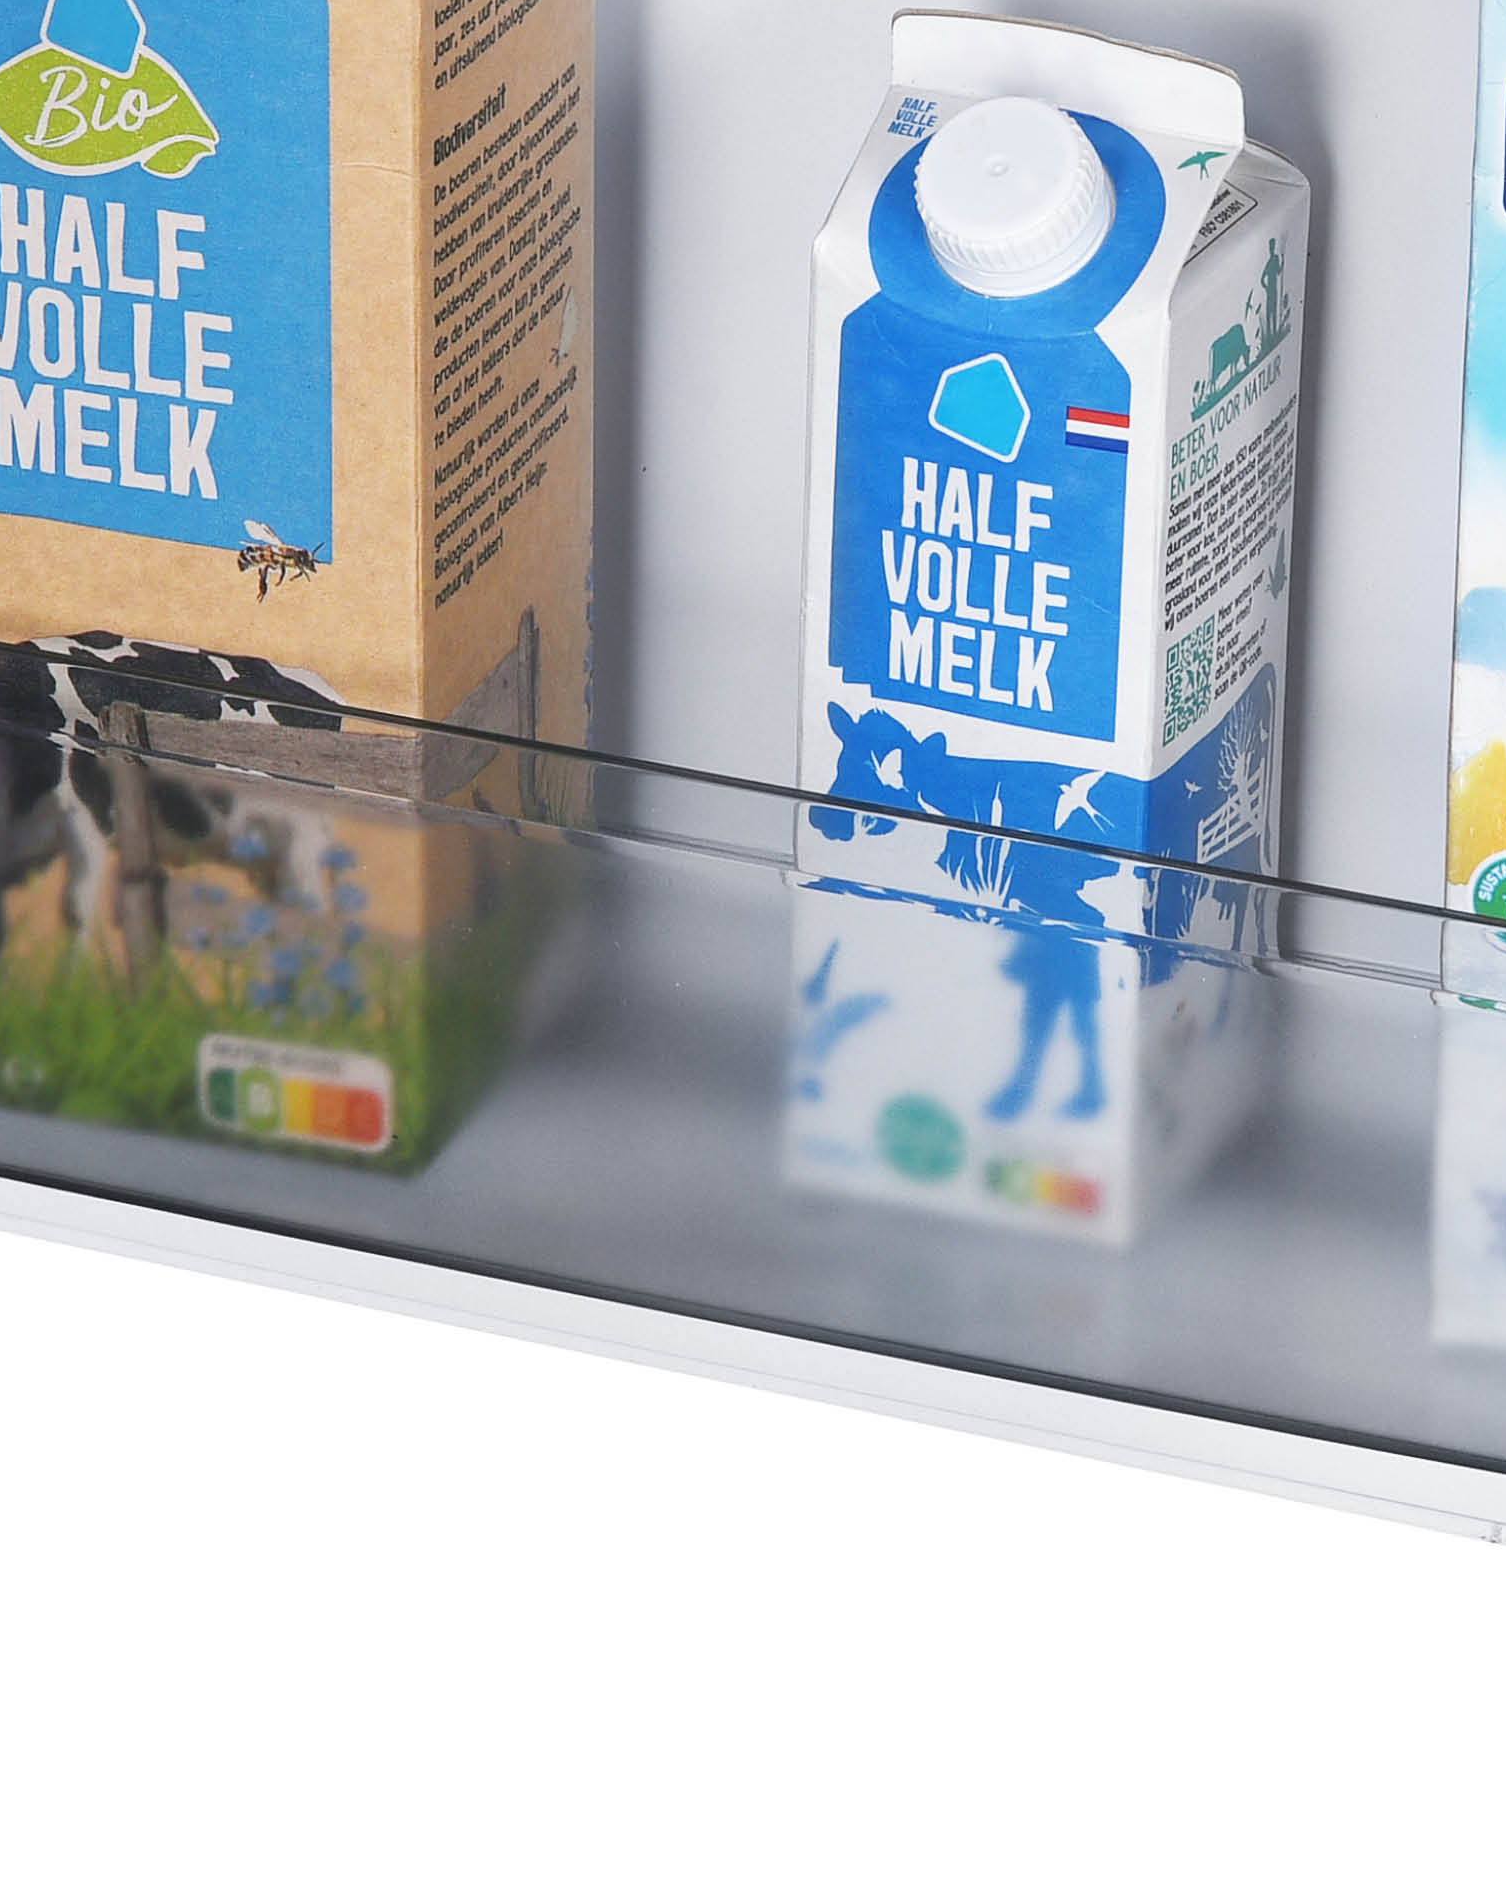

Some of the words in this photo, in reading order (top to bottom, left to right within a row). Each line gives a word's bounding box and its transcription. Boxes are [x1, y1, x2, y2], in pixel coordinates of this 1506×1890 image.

[23, 65, 179, 149] Bio
[435, 66, 447, 92] en
[896, 109, 939, 130] VOLLE
[901, 95, 938, 114] HALF
[433, 80, 506, 169] Biodiversiteit
[434, 178, 446, 208] De
[449, 150, 481, 195] boeren
[482, 113, 521, 168] besteden
[886, 120, 926, 140] MELK
[434, 222, 467, 268] hebben
[434, 262, 456, 300] Daar
[458, 221, 504, 284] profiteren
[1171, 420, 1205, 471] BETER
[1209, 390, 1240, 440] VOOR
[1244, 352, 1281, 411] NATUUR
[900, 455, 1055, 553] HALF
[1170, 466, 1185, 503] EN
[1190, 440, 1218, 487] BOER
[881, 528, 1072, 637] VOLLE
[887, 608, 1057, 713] MELK
